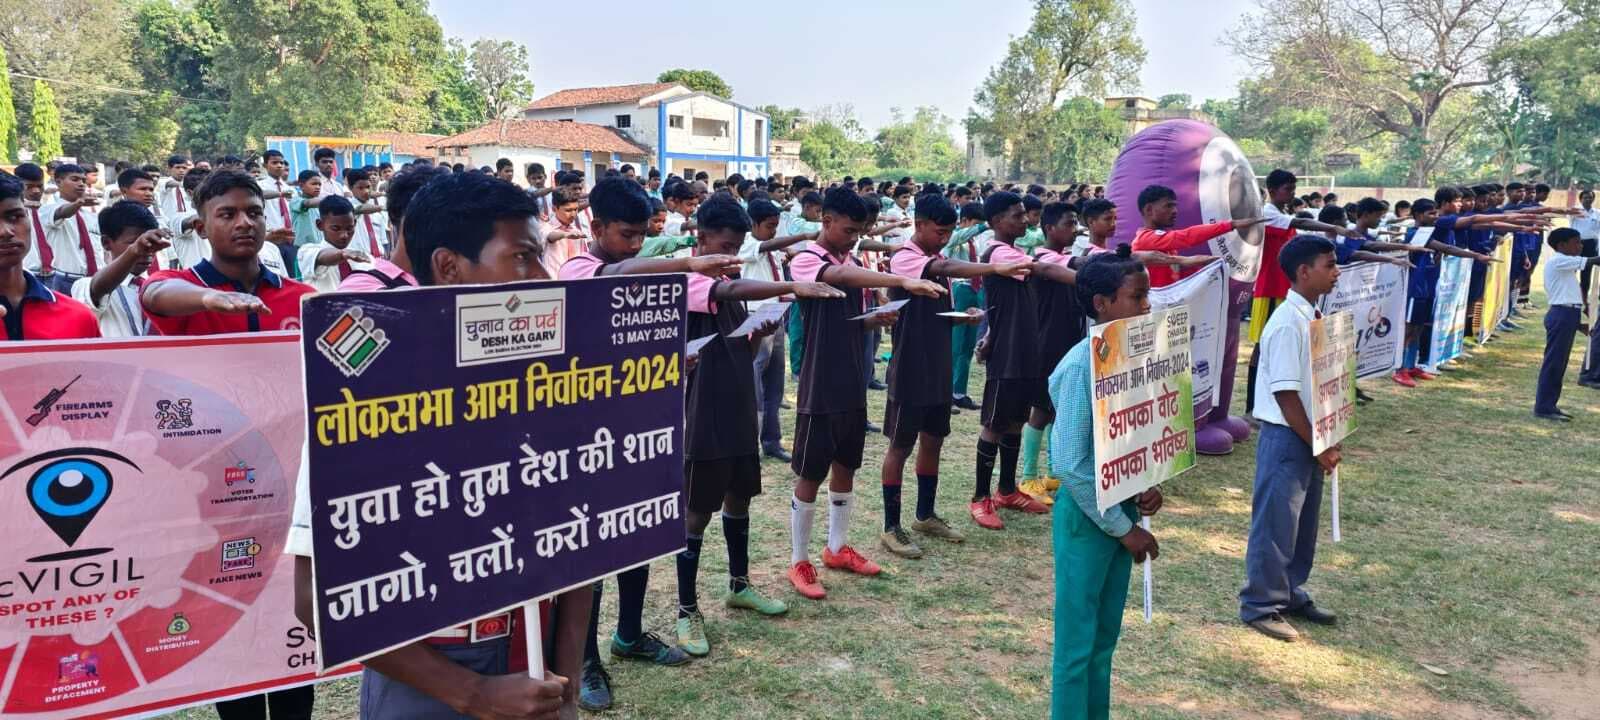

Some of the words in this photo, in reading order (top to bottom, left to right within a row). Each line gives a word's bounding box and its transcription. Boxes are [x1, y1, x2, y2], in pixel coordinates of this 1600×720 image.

[611, 283, 683, 309] SWEEP
[464, 318, 504, 342] चुनाव
[508, 315, 531, 332] का
[534, 305, 558, 329] पर्व
[611, 308, 680, 327] CHAIBASA
[481, 335, 509, 348] DESH
[511, 333, 526, 344] KA
[527, 330, 556, 342] GARV
[611, 333, 624, 345] 13
[627, 330, 652, 344] MAY
[654, 326, 679, 341] 2024
[1095, 371, 1128, 400] लोकसभा
[1130, 367, 1145, 389] आम
[56, 401, 113, 411] FIREARMS
[314, 388, 454, 446] लोकसभा
[463, 378, 518, 422] आम
[525, 352, 680, 412] निर्वाचन-2024
[61, 411, 109, 421] DISPLAY
[1109, 400, 1154, 440] आपका
[1157, 383, 1179, 418] वोट
[163, 428, 222, 438] INTIMIDATION
[1101, 447, 1148, 490] आपका
[1152, 426, 1188, 463] भविष्य
[231, 488, 254, 496] VOTER
[328, 484, 401, 549] युवा
[411, 461, 451, 518] हो
[460, 461, 511, 518] तुम
[519, 442, 570, 488] देश
[577, 427, 615, 474] की
[623, 426, 674, 464] शान
[211, 493, 274, 504] TRANSPORTATION
[226, 540, 251, 549] NEWS
[325, 551, 437, 621] जागो,
[449, 523, 524, 583] चलों,
[534, 503, 590, 558] करों
[597, 491, 680, 540] मतदान
[209, 575, 234, 584] FAKE
[235, 571, 262, 581] NEWS
[0, 600, 56, 616] SPOT
[63, 593, 106, 608] ANY
[114, 588, 140, 601] OF
[26, 610, 96, 628] THESE
[146, 639, 200, 652] DISTRIBUTION
[159, 635, 187, 645] MONEY
[45, 686, 106, 703] DEFACEMENT
[52, 680, 99, 693] PROPERTY
